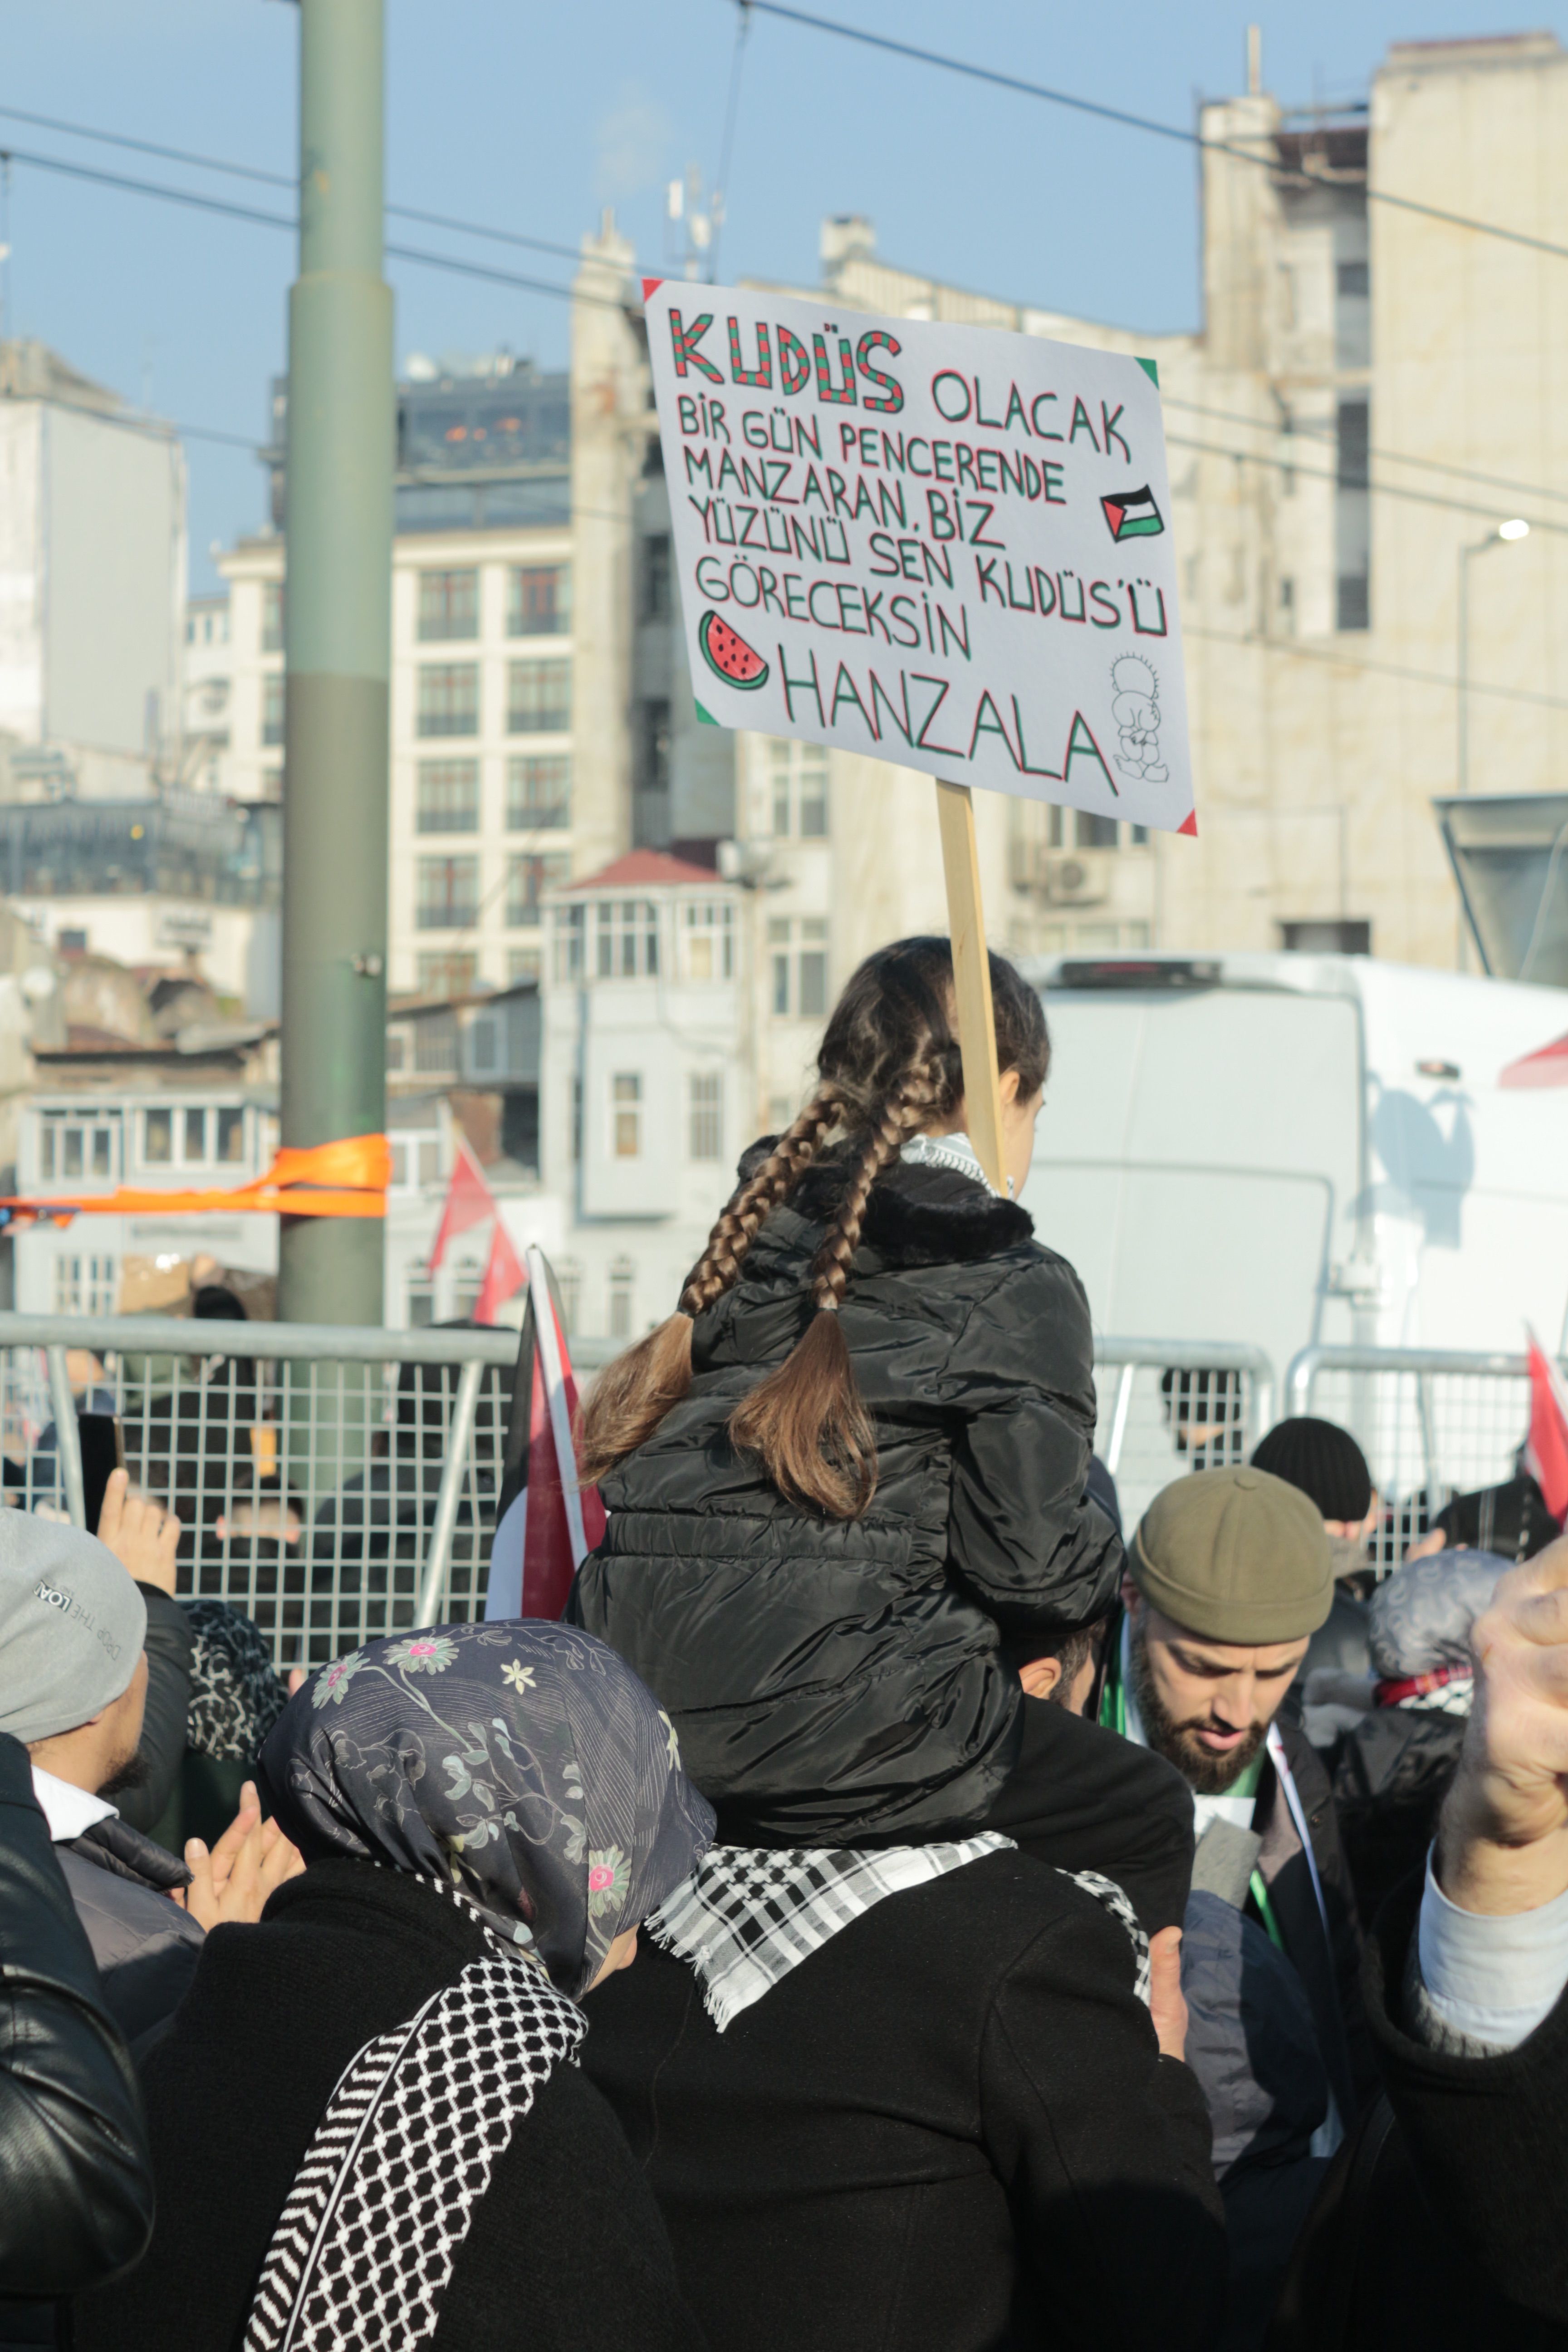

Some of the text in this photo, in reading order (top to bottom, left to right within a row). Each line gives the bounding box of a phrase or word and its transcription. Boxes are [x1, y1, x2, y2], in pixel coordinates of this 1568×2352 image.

[668, 308, 1131, 464] KUDÜS OLACAK
[677, 392, 1067, 505] BİR GÜN PENCERENDE
[688, 495, 1167, 637] YÜZÜNÜ SEN KUDÜS'Ü
[926, 488, 1006, 550] BİZ
[696, 554, 971, 661] GÖRECEKSİN
[778, 643, 1119, 797] HANZALA
[70, 1604, 95, 1632] THE
